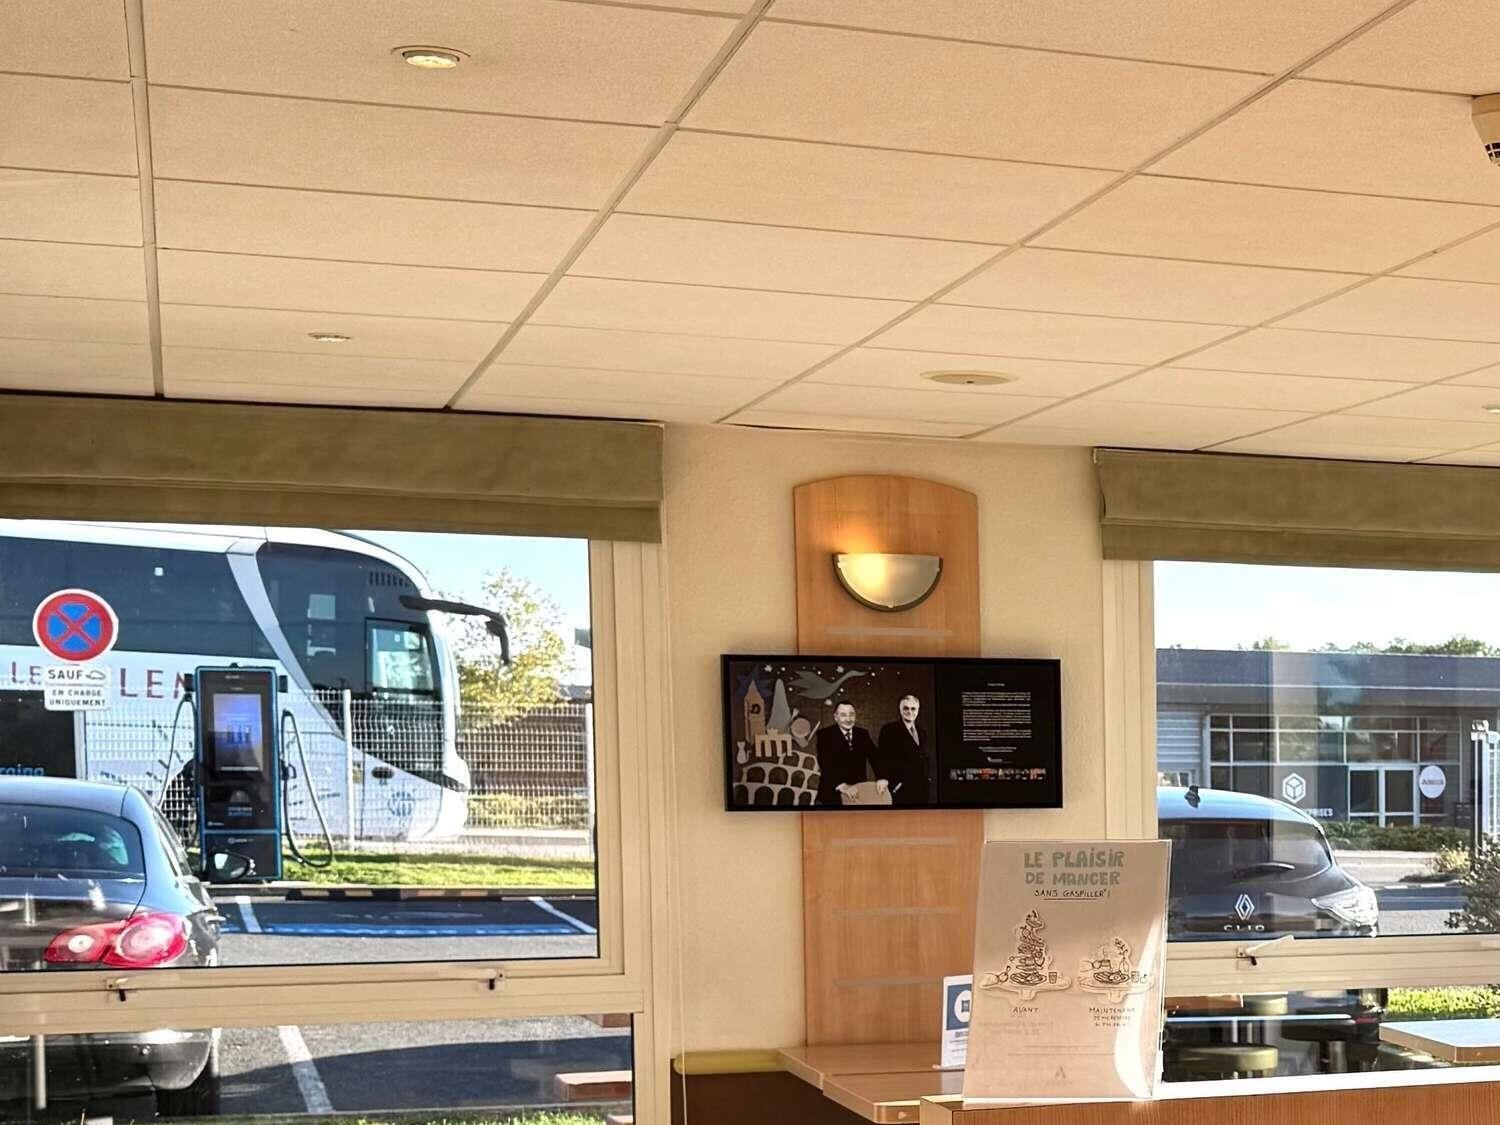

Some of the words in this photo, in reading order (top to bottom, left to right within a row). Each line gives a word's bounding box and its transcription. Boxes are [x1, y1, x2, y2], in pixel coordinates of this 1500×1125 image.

[48, 669, 83, 680] SAUF
[68, 689, 101, 697] CHARGE
[49, 698, 106, 707] UNIQUEMENT
[1024, 851, 1043, 868] LE
[1025, 871, 1044, 885] DE
[1034, 889, 1058, 897] SANS
